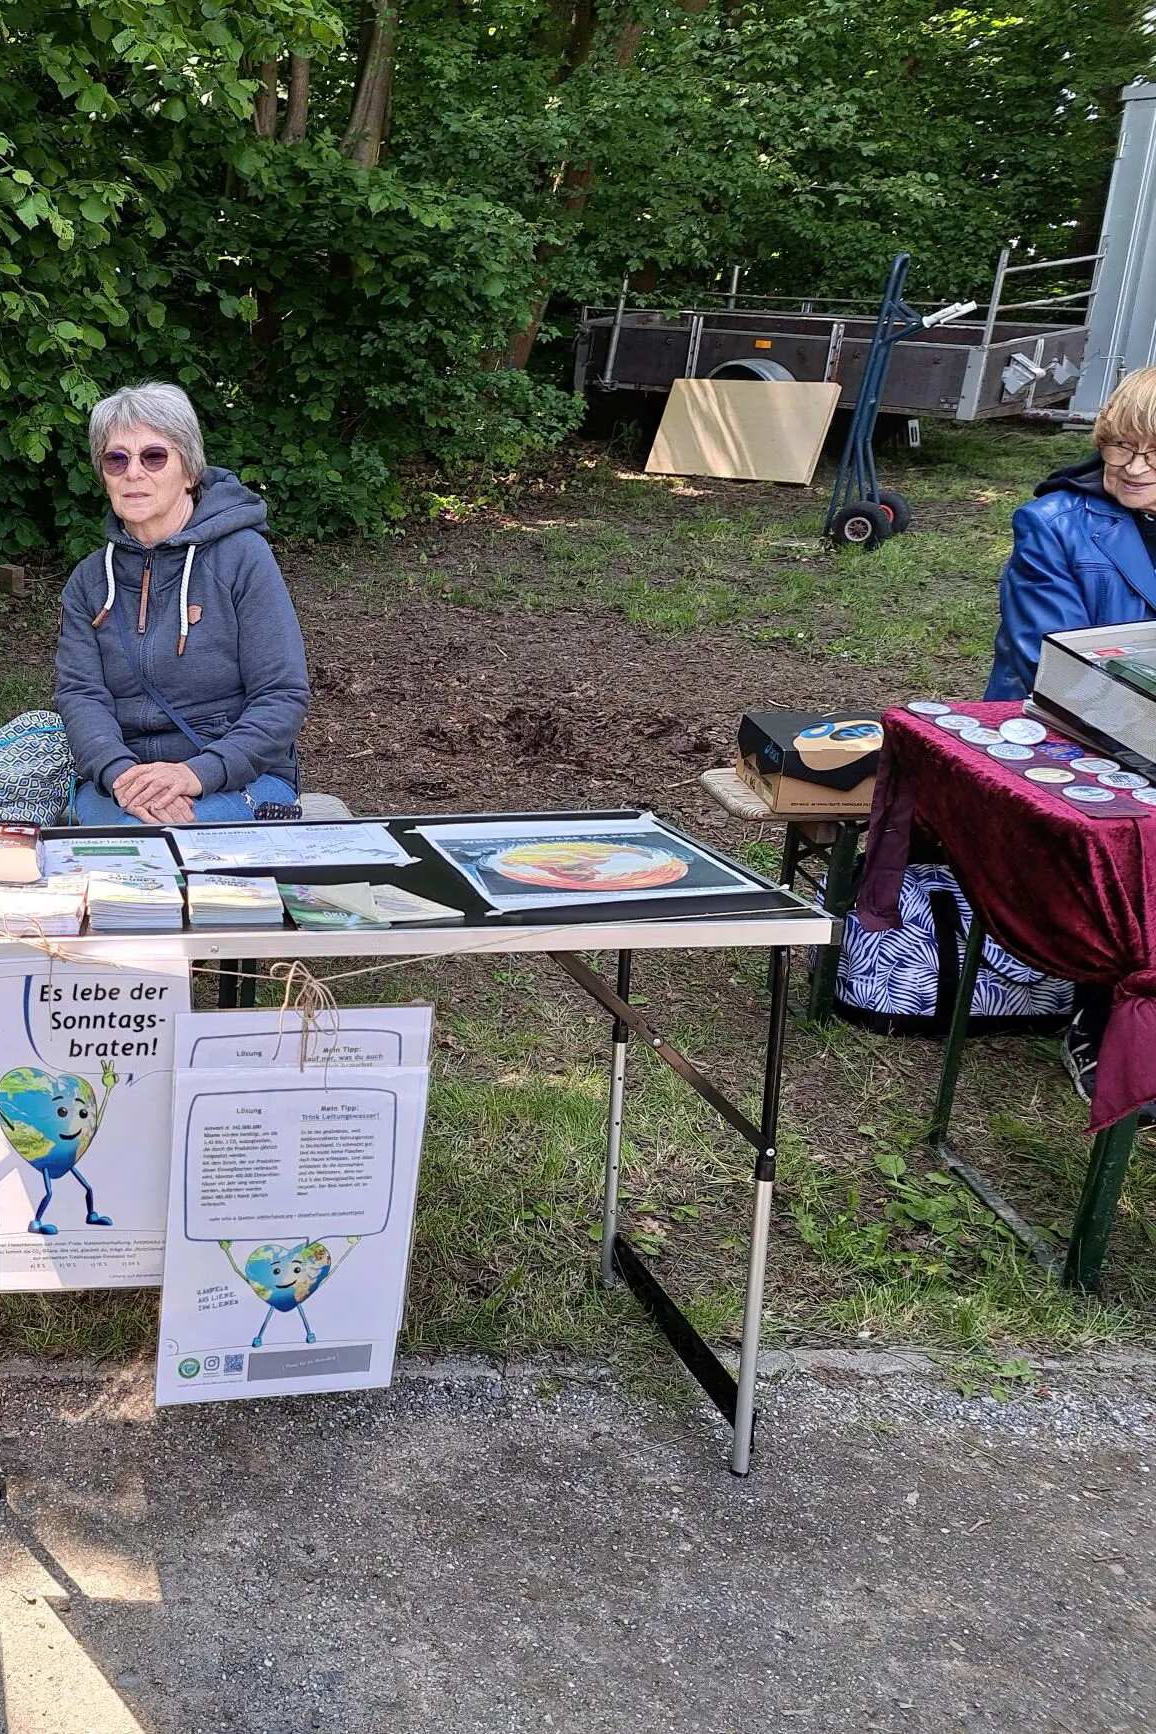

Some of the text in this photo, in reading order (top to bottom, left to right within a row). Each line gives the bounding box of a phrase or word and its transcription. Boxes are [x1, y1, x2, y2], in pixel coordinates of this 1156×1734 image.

[39, 983, 168, 1002] Es lebe der
[51, 1012, 166, 1032] Sonntags-
[69, 1038, 158, 1057] braten!
